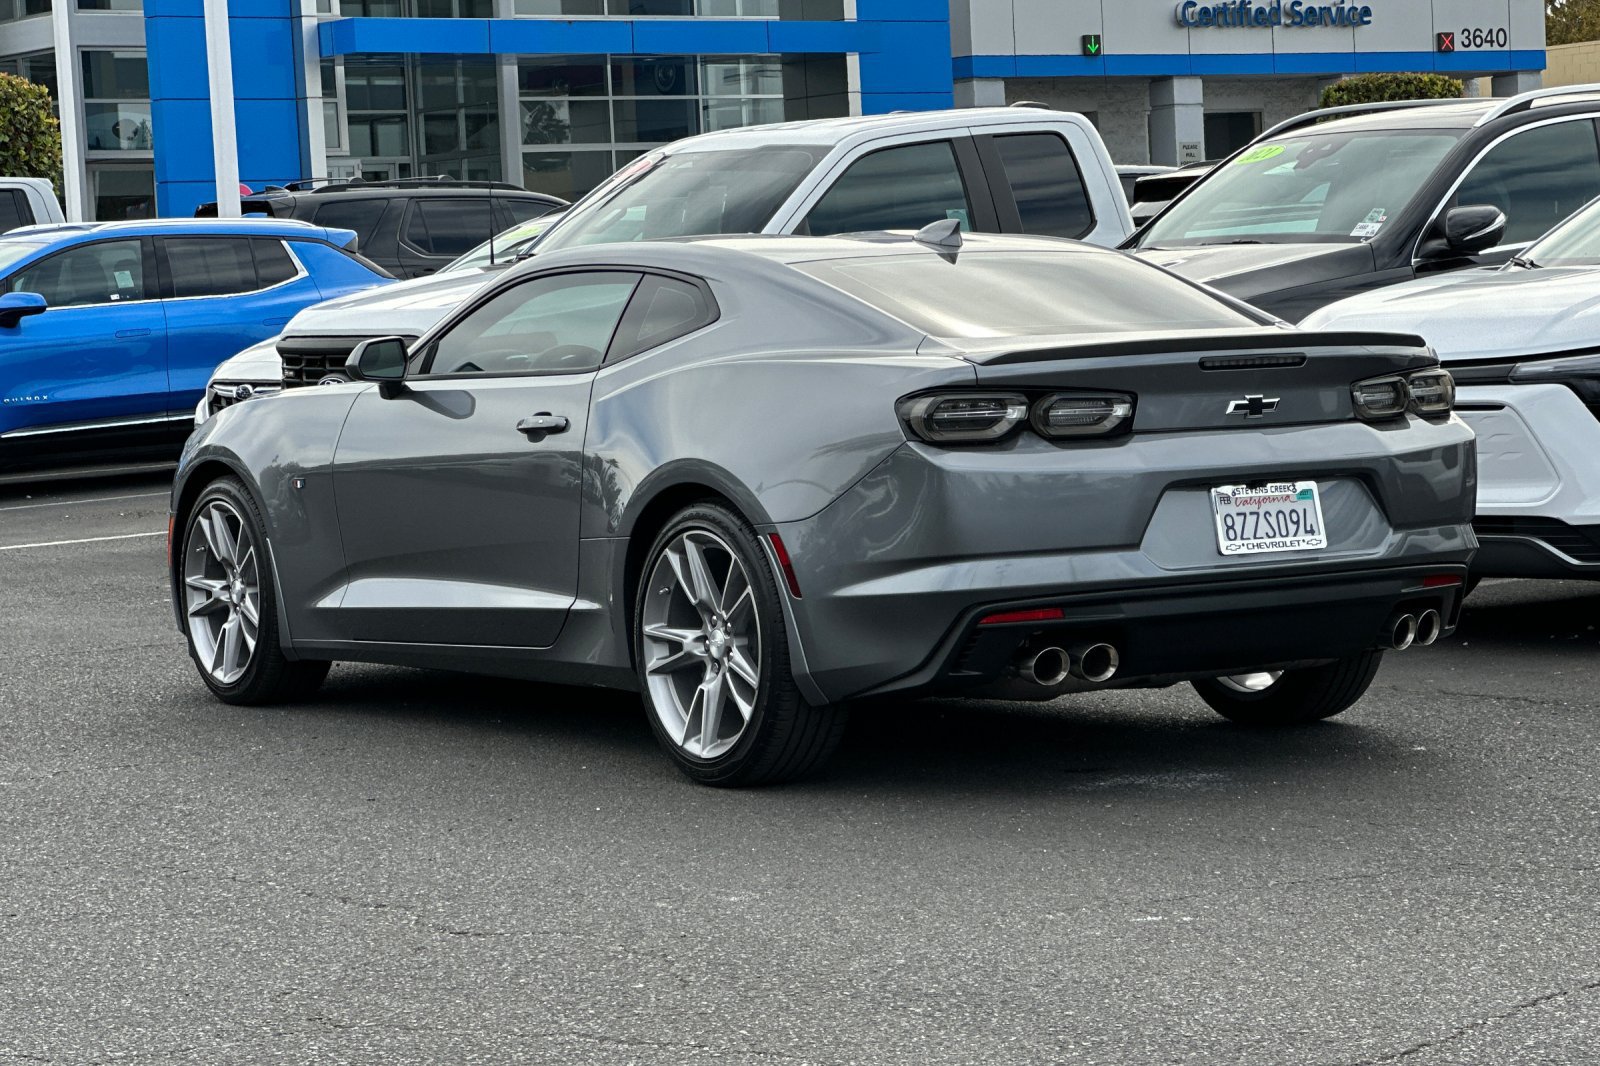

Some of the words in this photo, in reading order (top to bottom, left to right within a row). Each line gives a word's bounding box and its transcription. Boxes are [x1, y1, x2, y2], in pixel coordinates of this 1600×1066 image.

[1179, 0, 1282, 27] Certified
[1287, 0, 1373, 27] Service
[1461, 28, 1507, 48] 3640
[1235, 486, 1268, 496] STEVENS
[1269, 484, 1293, 494] CREEK
[1219, 496, 1232, 505] FEB
[1234, 495, 1298, 510] California
[1223, 507, 1316, 542] 8ZZS094
[1246, 540, 1301, 551] CHEVROLET
